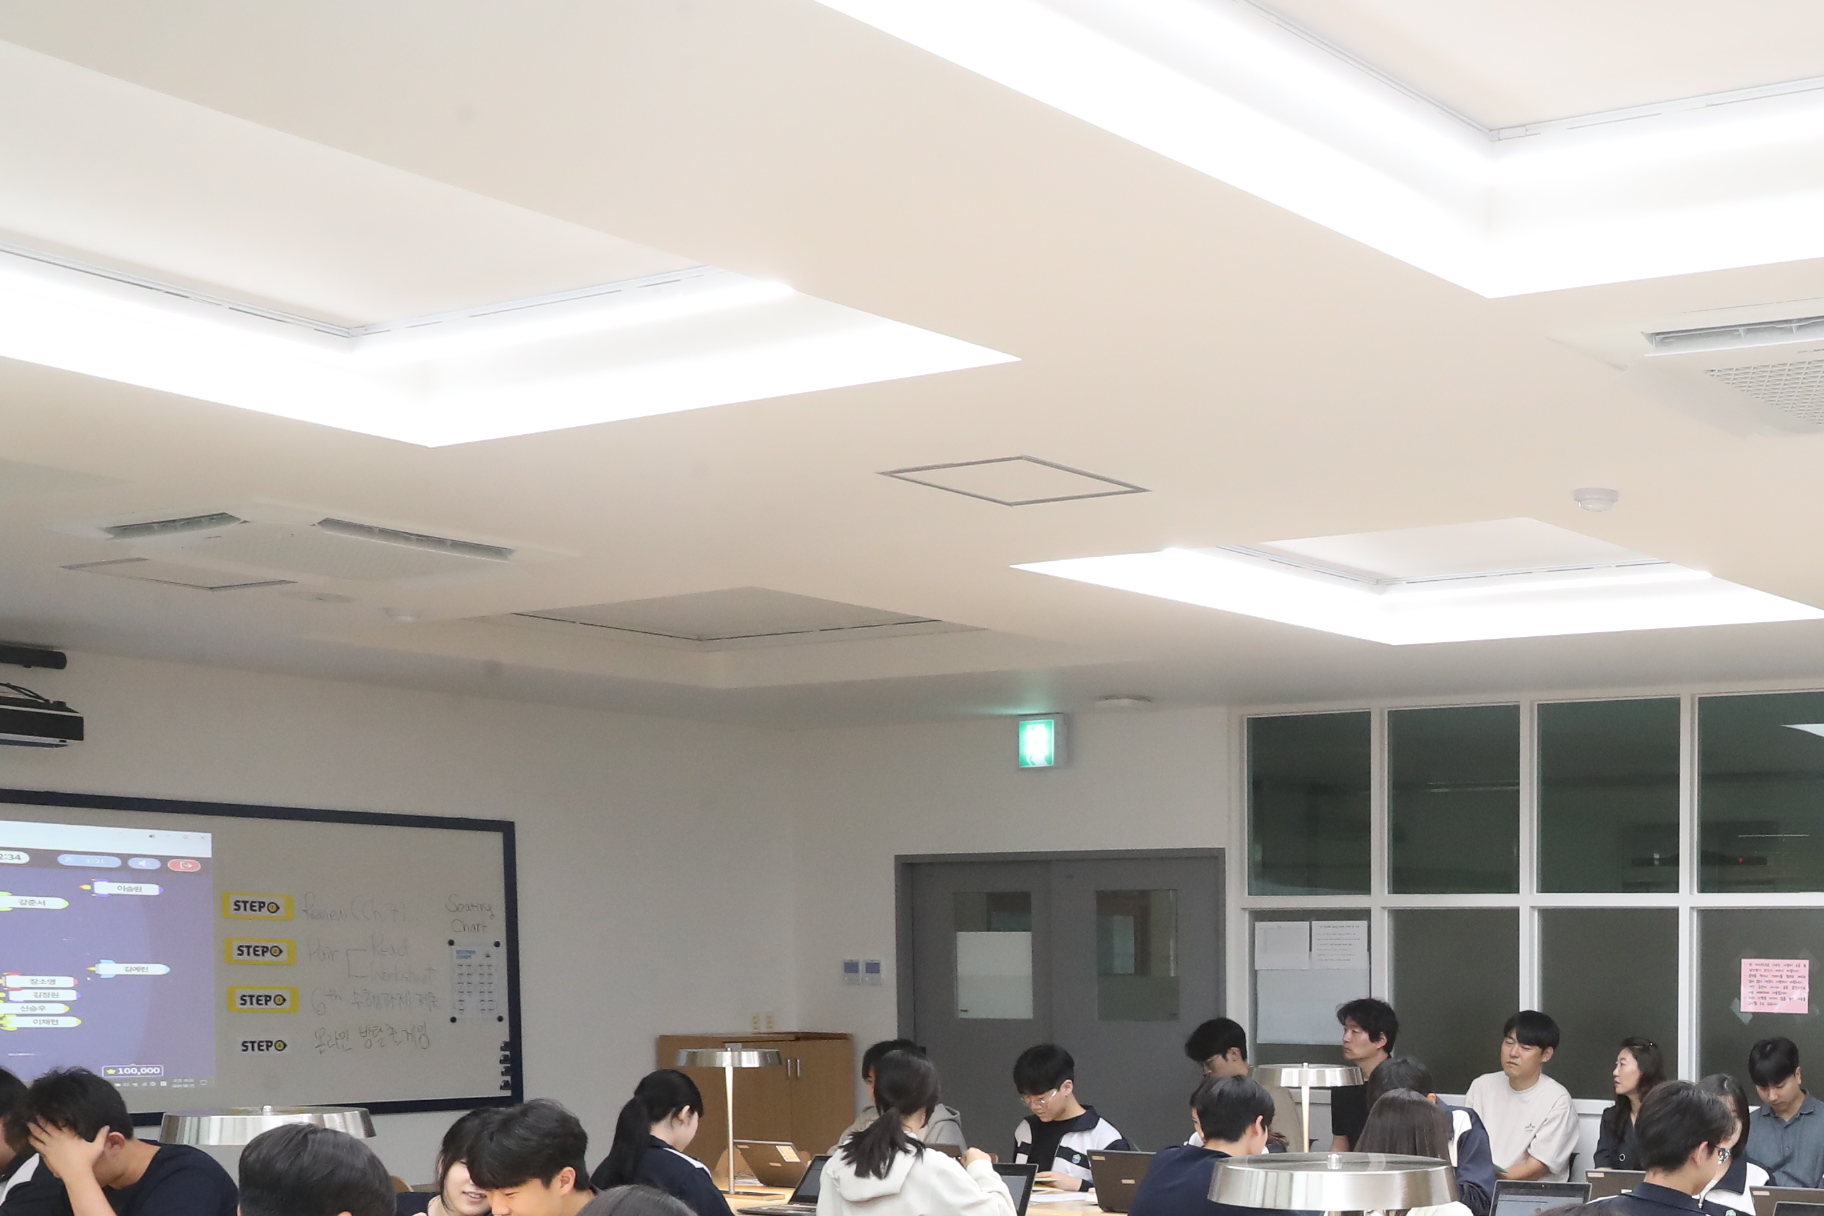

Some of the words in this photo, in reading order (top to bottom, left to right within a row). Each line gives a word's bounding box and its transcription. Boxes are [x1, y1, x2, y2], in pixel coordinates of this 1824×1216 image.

[233, 900, 266, 912] STEP
[451, 918, 487, 933] Chart
[237, 945, 269, 957] STEP
[239, 994, 272, 1006] STEP
[241, 1040, 274, 1052] STEP
[117, 1067, 161, 1075] 100,000
